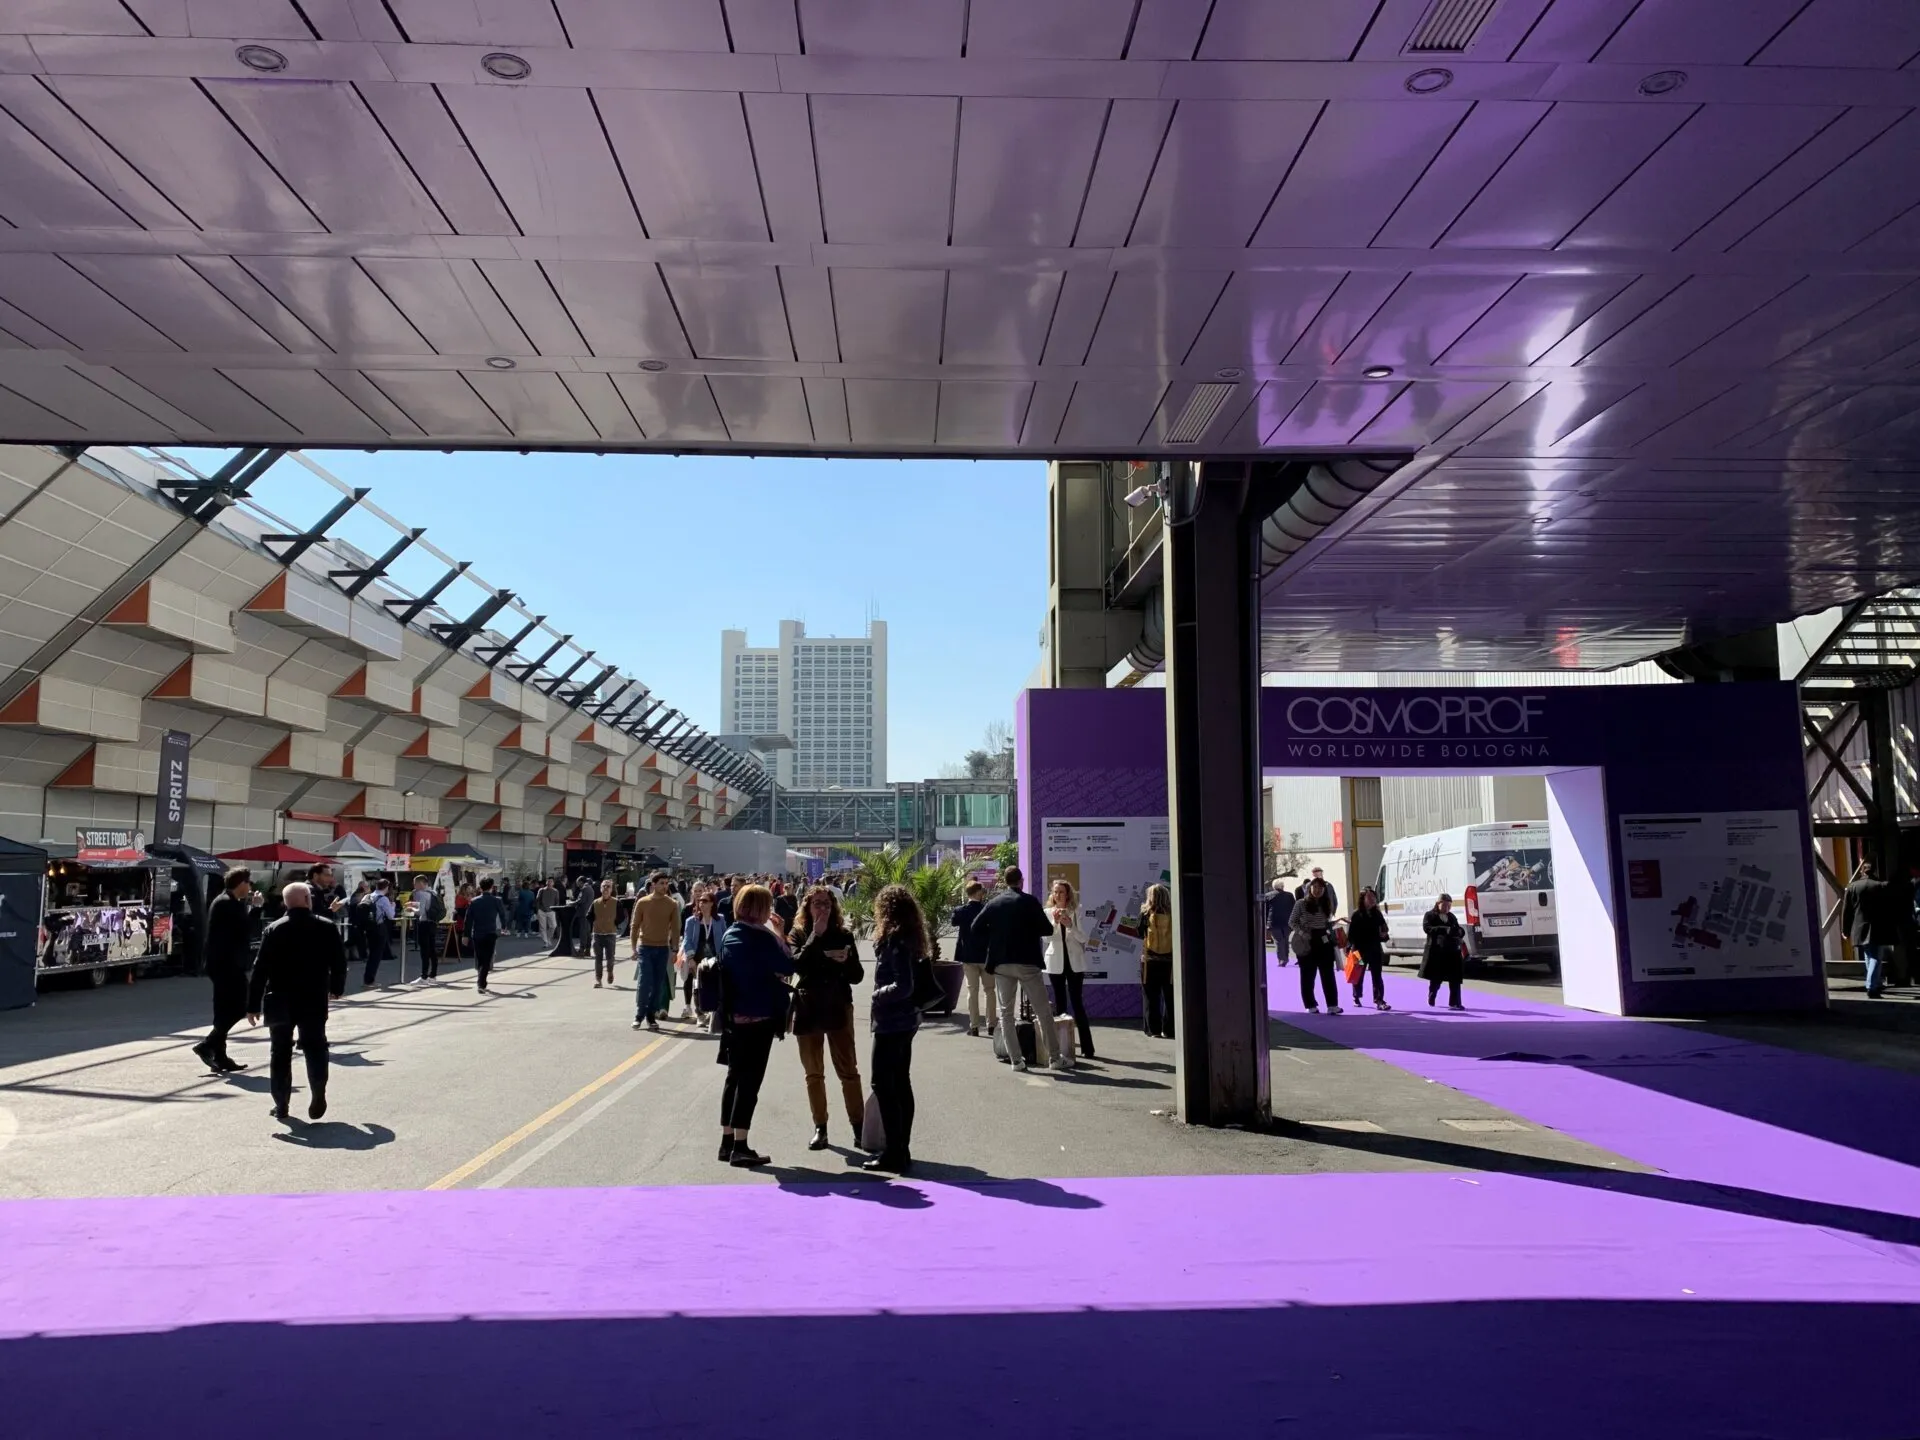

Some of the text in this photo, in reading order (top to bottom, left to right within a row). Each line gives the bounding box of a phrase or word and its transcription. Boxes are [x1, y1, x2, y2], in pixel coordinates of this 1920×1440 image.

[1287, 696, 1546, 734] COSMOPROF
[1288, 743, 1549, 758] WORLDWIDE BOLOGNA
[168, 759, 183, 822] SPRITZ
[86, 831, 127, 846] STREET FOOD
